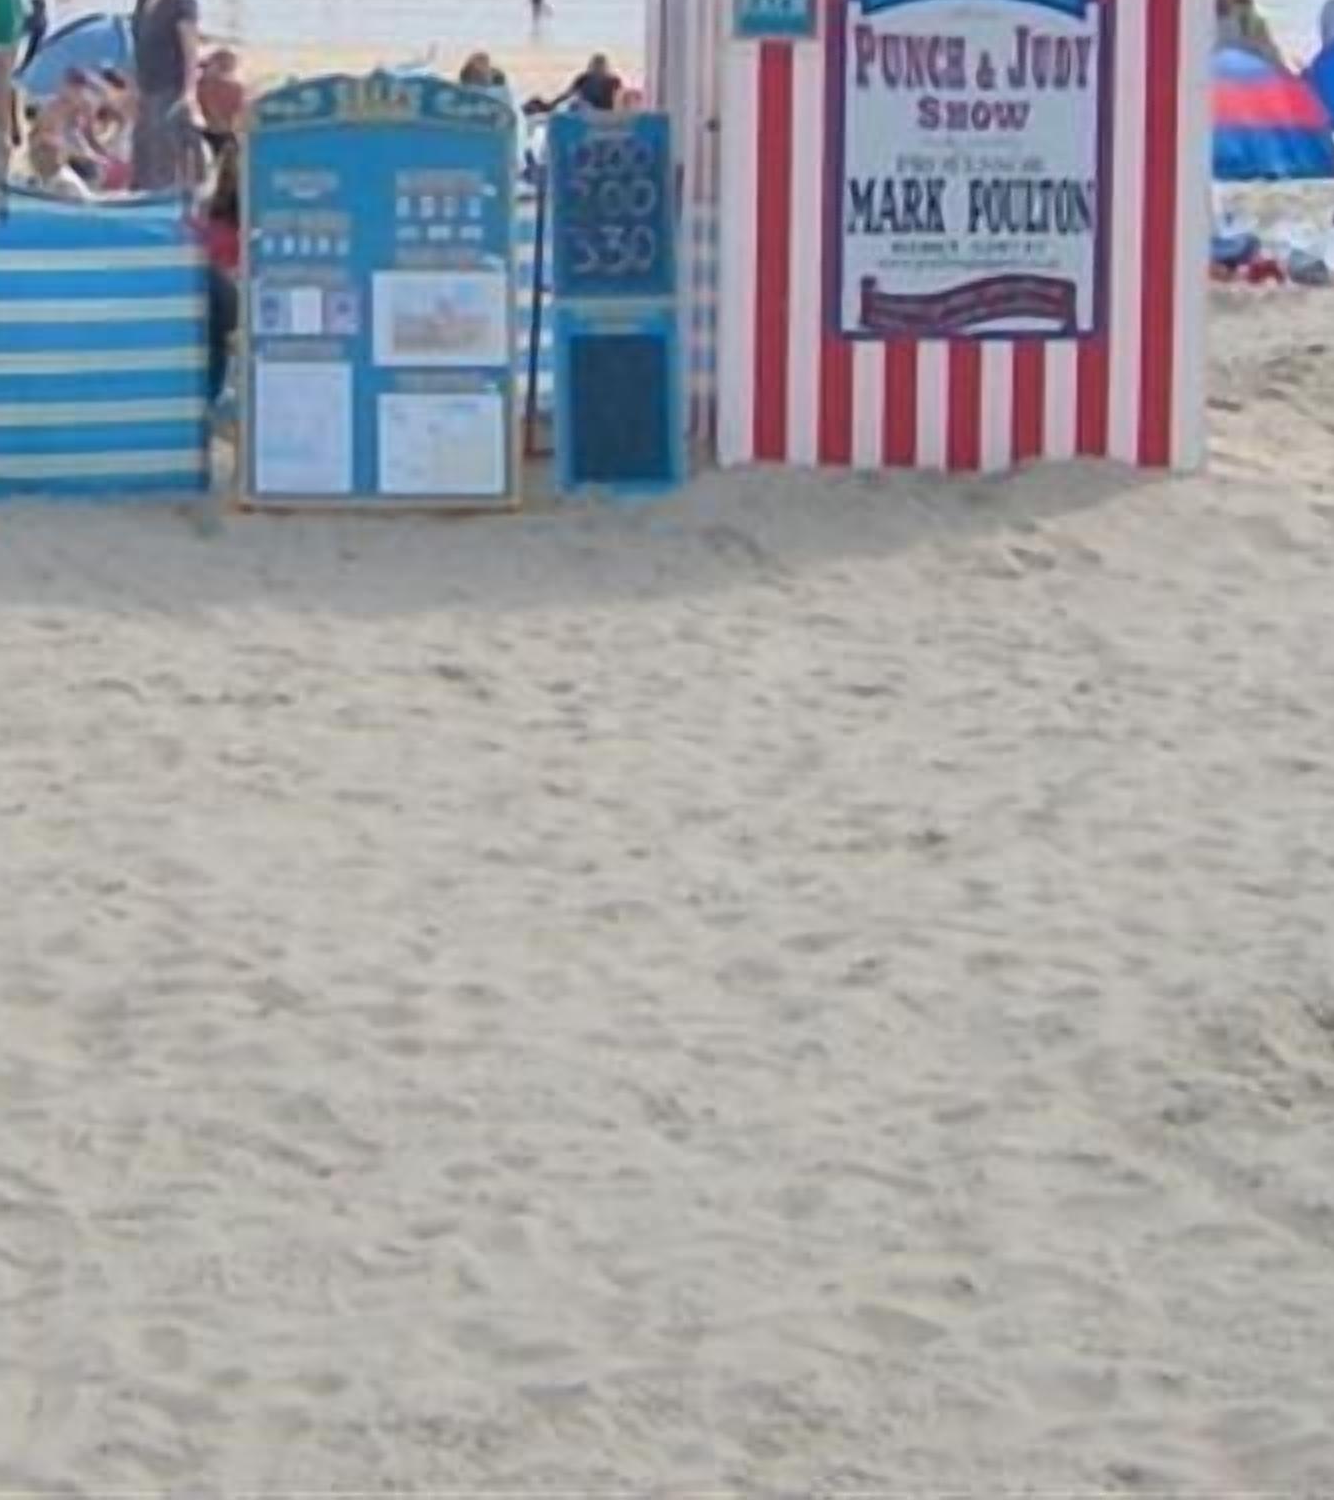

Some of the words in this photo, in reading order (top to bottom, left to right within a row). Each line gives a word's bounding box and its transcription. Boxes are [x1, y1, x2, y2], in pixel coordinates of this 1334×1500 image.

[854, 23, 968, 88] PUNCH
[975, 51, 996, 90] &
[1007, 25, 1093, 88] JUDY
[917, 96, 1031, 130] SHOW
[846, 176, 947, 234] MARK
[967, 176, 1095, 234] POULTON
